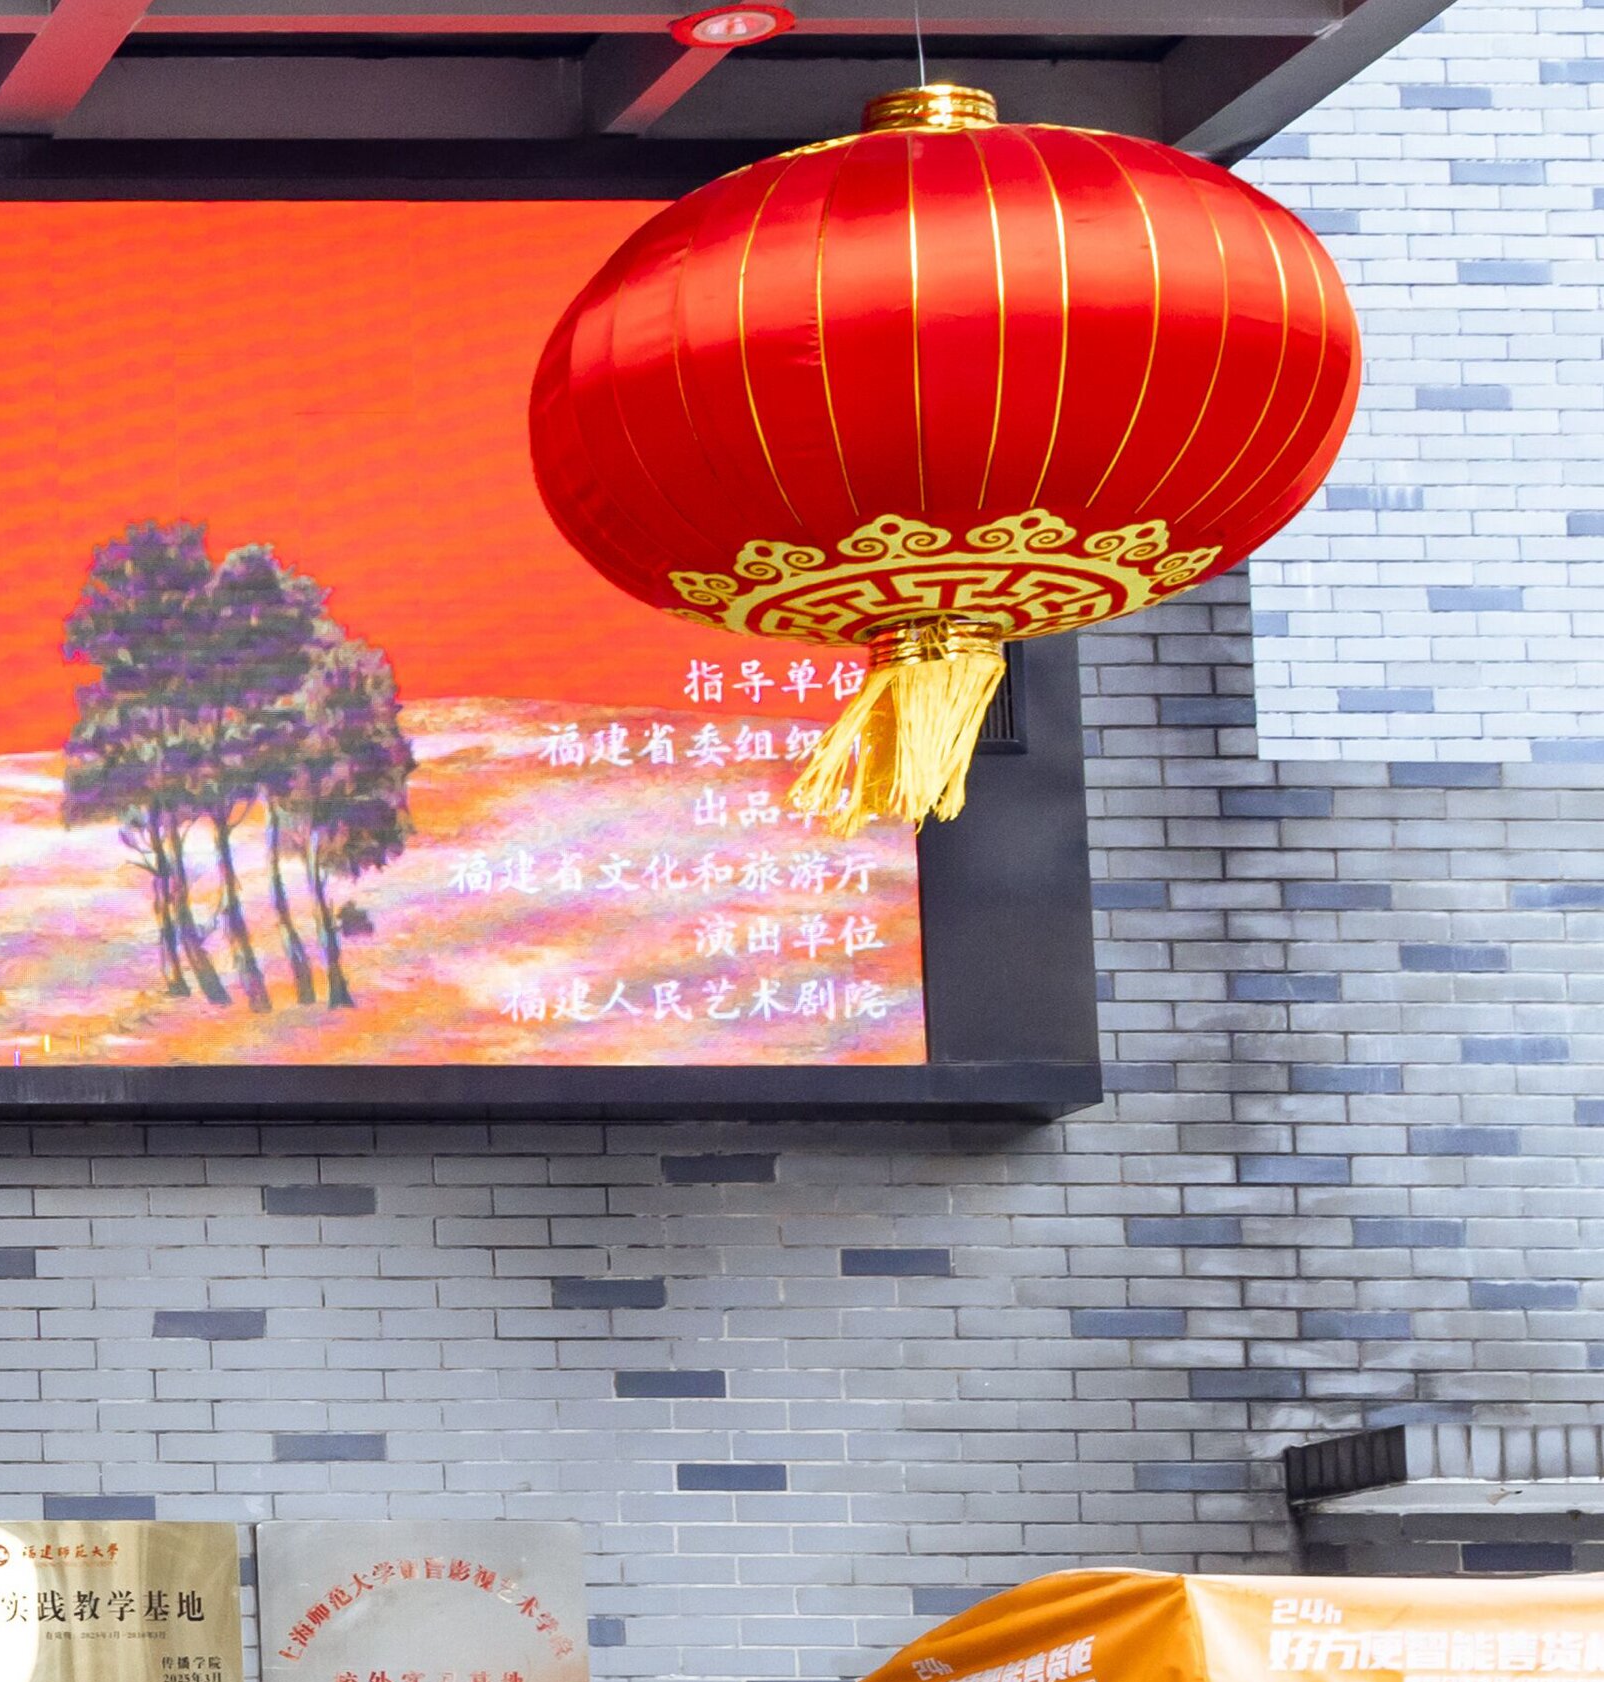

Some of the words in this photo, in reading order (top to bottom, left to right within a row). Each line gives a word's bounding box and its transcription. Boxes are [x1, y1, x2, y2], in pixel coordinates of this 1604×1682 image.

[683, 659, 866, 704] 指导单位
[539, 722, 872, 767] 福建省委组织
[448, 852, 878, 894] 福建省文化和旅游厅
[694, 914, 884, 958] 演出单位
[499, 979, 889, 1023] 福建人民艺术剧院
[1270, 1598, 1342, 1625] 24h
[162, 1656, 222, 1670] 传播学院
